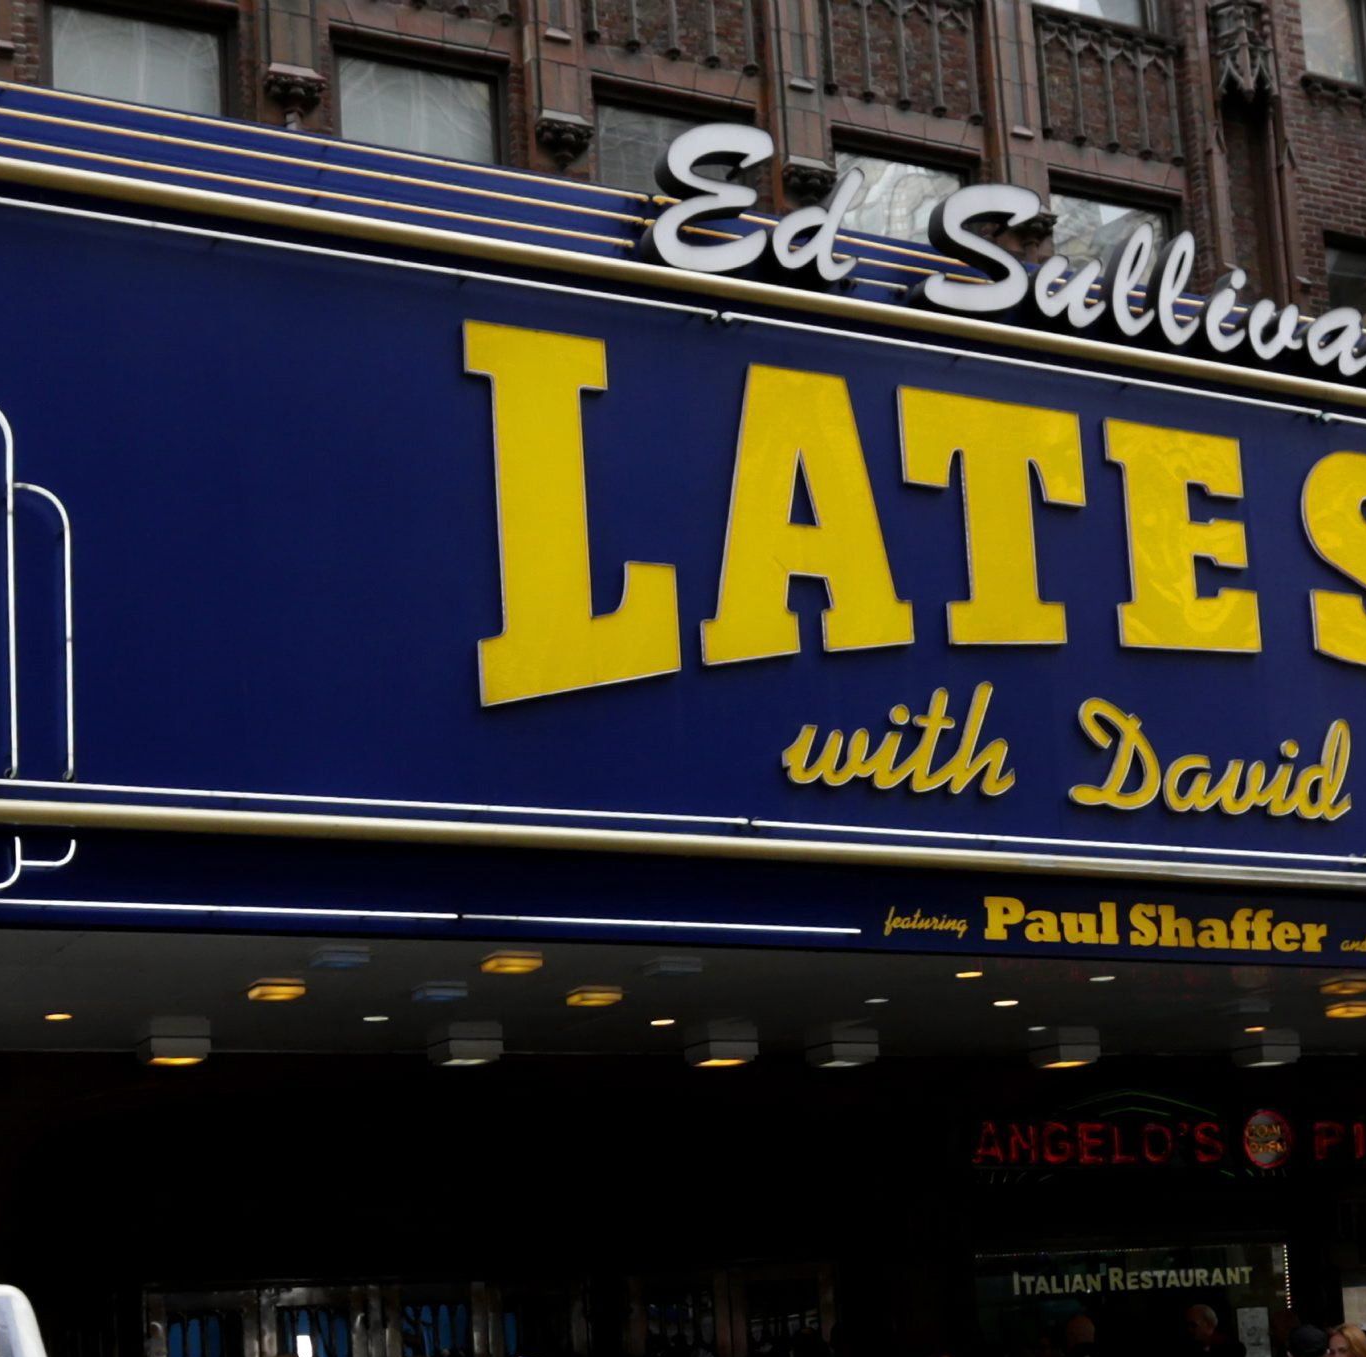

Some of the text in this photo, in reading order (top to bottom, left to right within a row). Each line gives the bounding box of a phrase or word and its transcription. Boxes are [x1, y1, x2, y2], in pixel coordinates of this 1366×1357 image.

[648, 121, 864, 284] Ed
[462, 319, 1262, 708] LATE
[782, 680, 1015, 797] with
[1068, 697, 1352, 822] David
[883, 905, 969, 938] featuring
[983, 896, 1120, 945] Paul
[1129, 903, 1328, 953] Shaffer
[972, 1119, 1227, 1166] ANGELO'S
[1011, 1266, 1254, 1297] ITALIAN RESTAURANT
